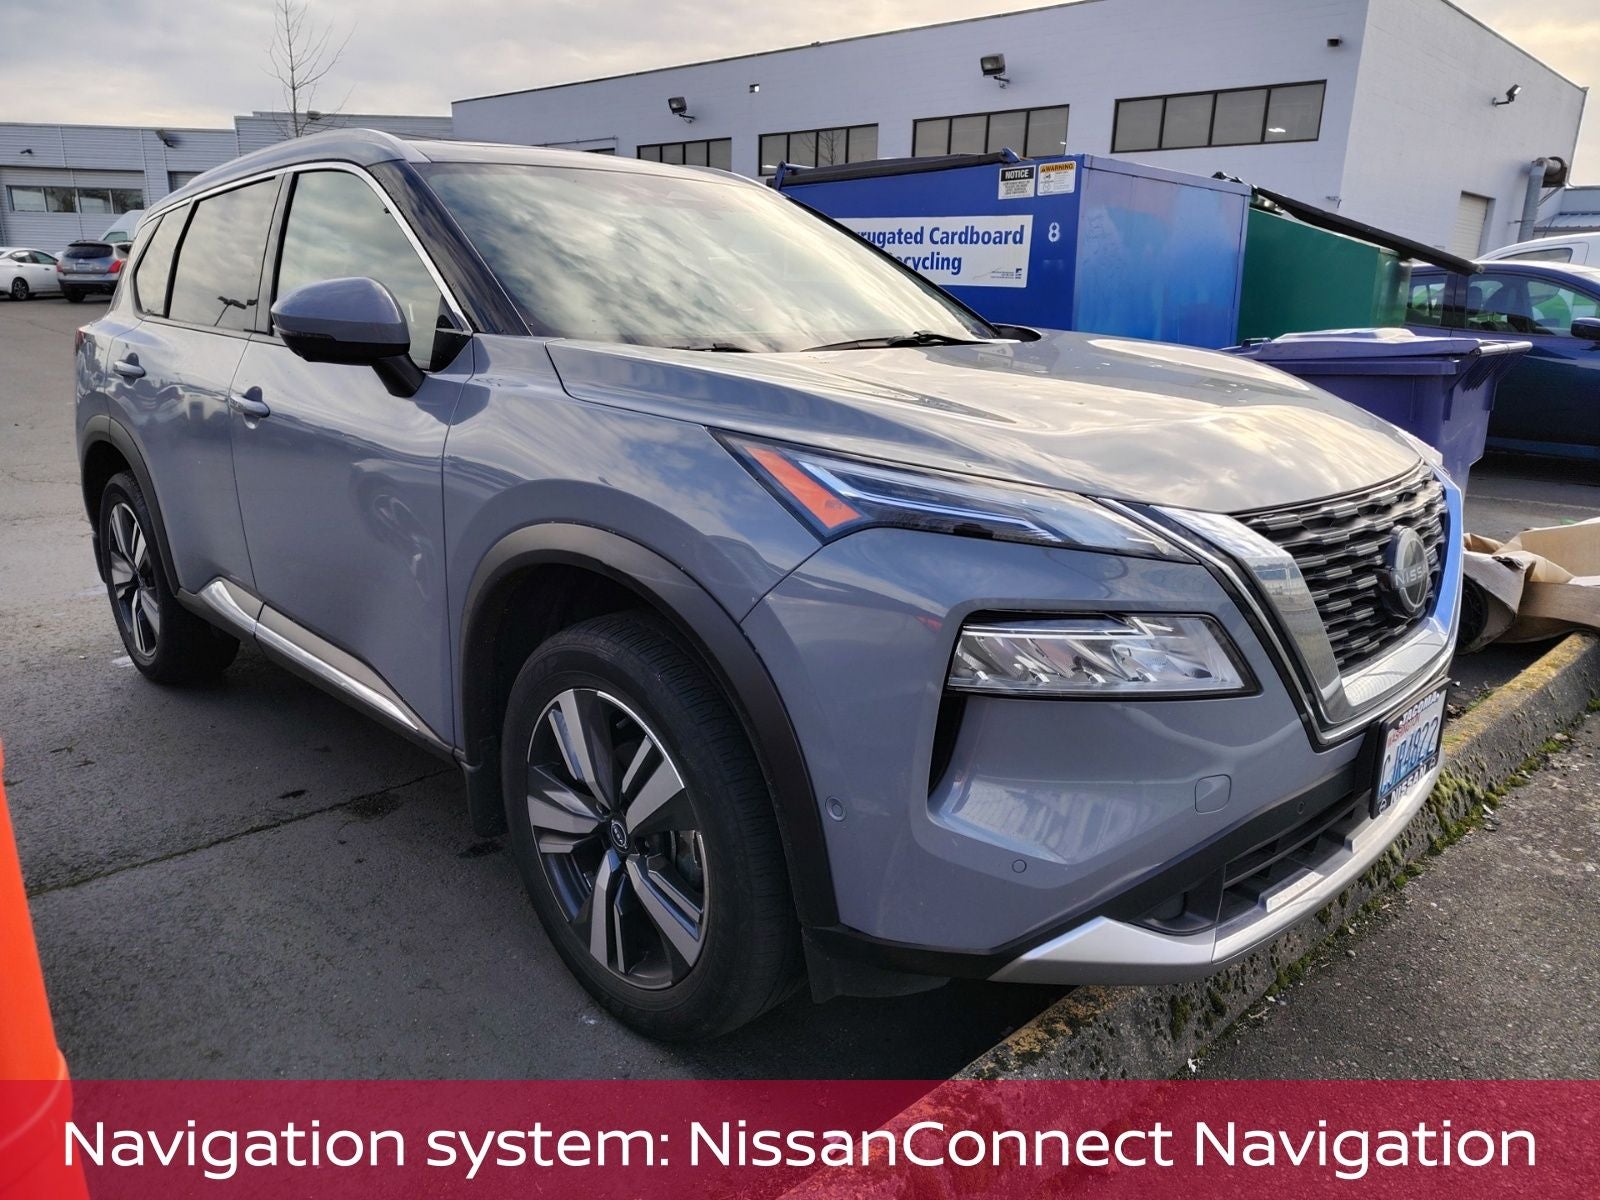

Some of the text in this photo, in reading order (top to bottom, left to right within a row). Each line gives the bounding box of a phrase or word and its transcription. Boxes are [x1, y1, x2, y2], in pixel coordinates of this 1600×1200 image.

[1005, 169, 1030, 179] NOTICE
[1045, 163, 1075, 172] WARNING
[929, 225, 1025, 245] Cardboard
[1048, 221, 1061, 243] 8
[1391, 763, 1427, 804] NISSAN
